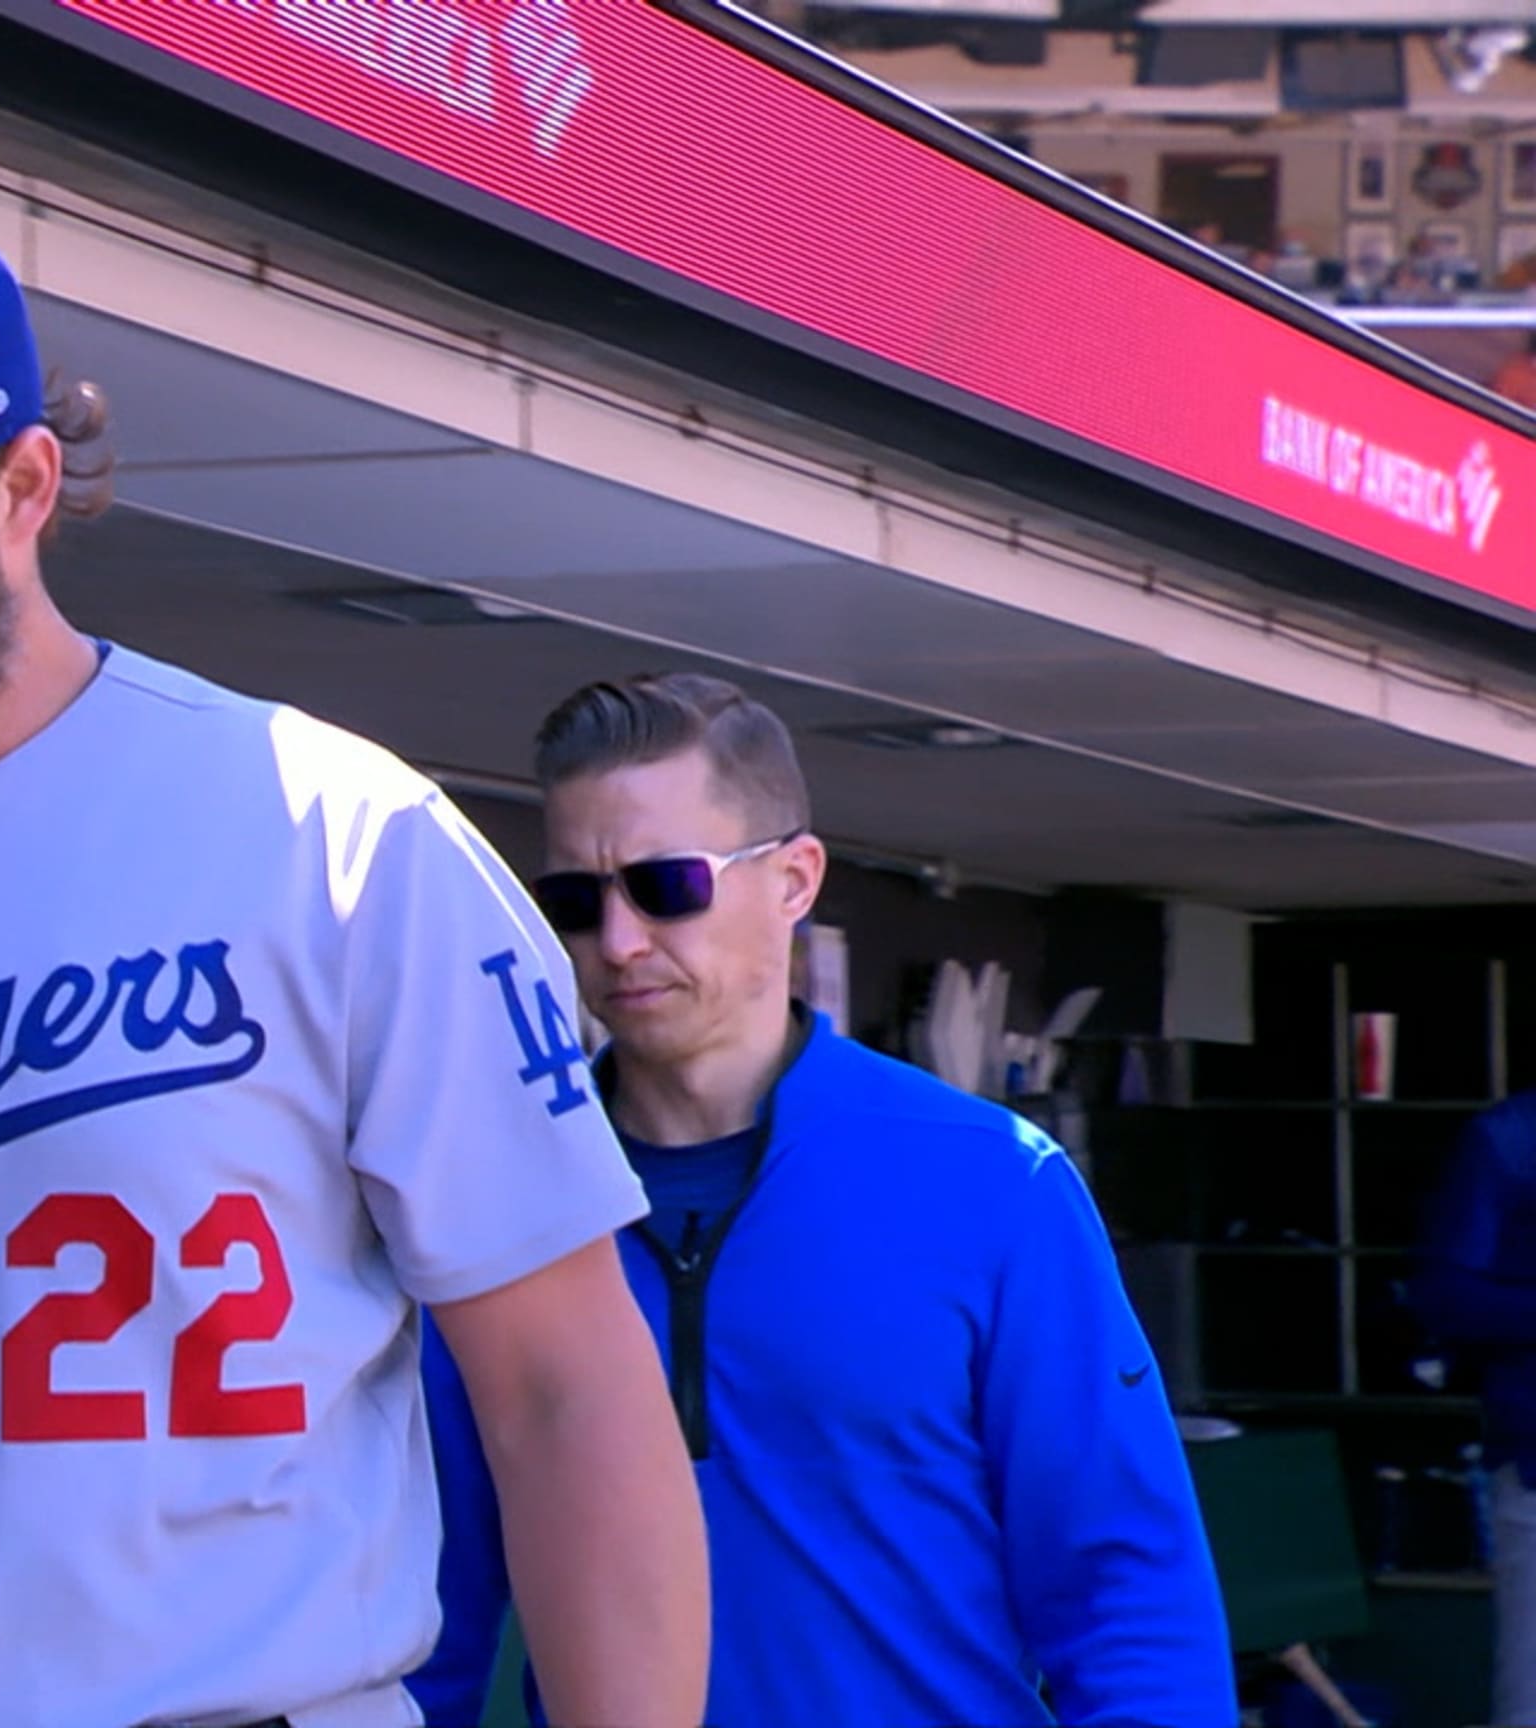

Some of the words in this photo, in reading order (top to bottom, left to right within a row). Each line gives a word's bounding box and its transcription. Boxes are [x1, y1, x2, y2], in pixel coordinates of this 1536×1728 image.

[1262, 396, 1329, 485] BANK
[1328, 426, 1363, 497] OF
[1360, 440, 1457, 537] AMERICA
[0, 1193, 305, 1442] 22
